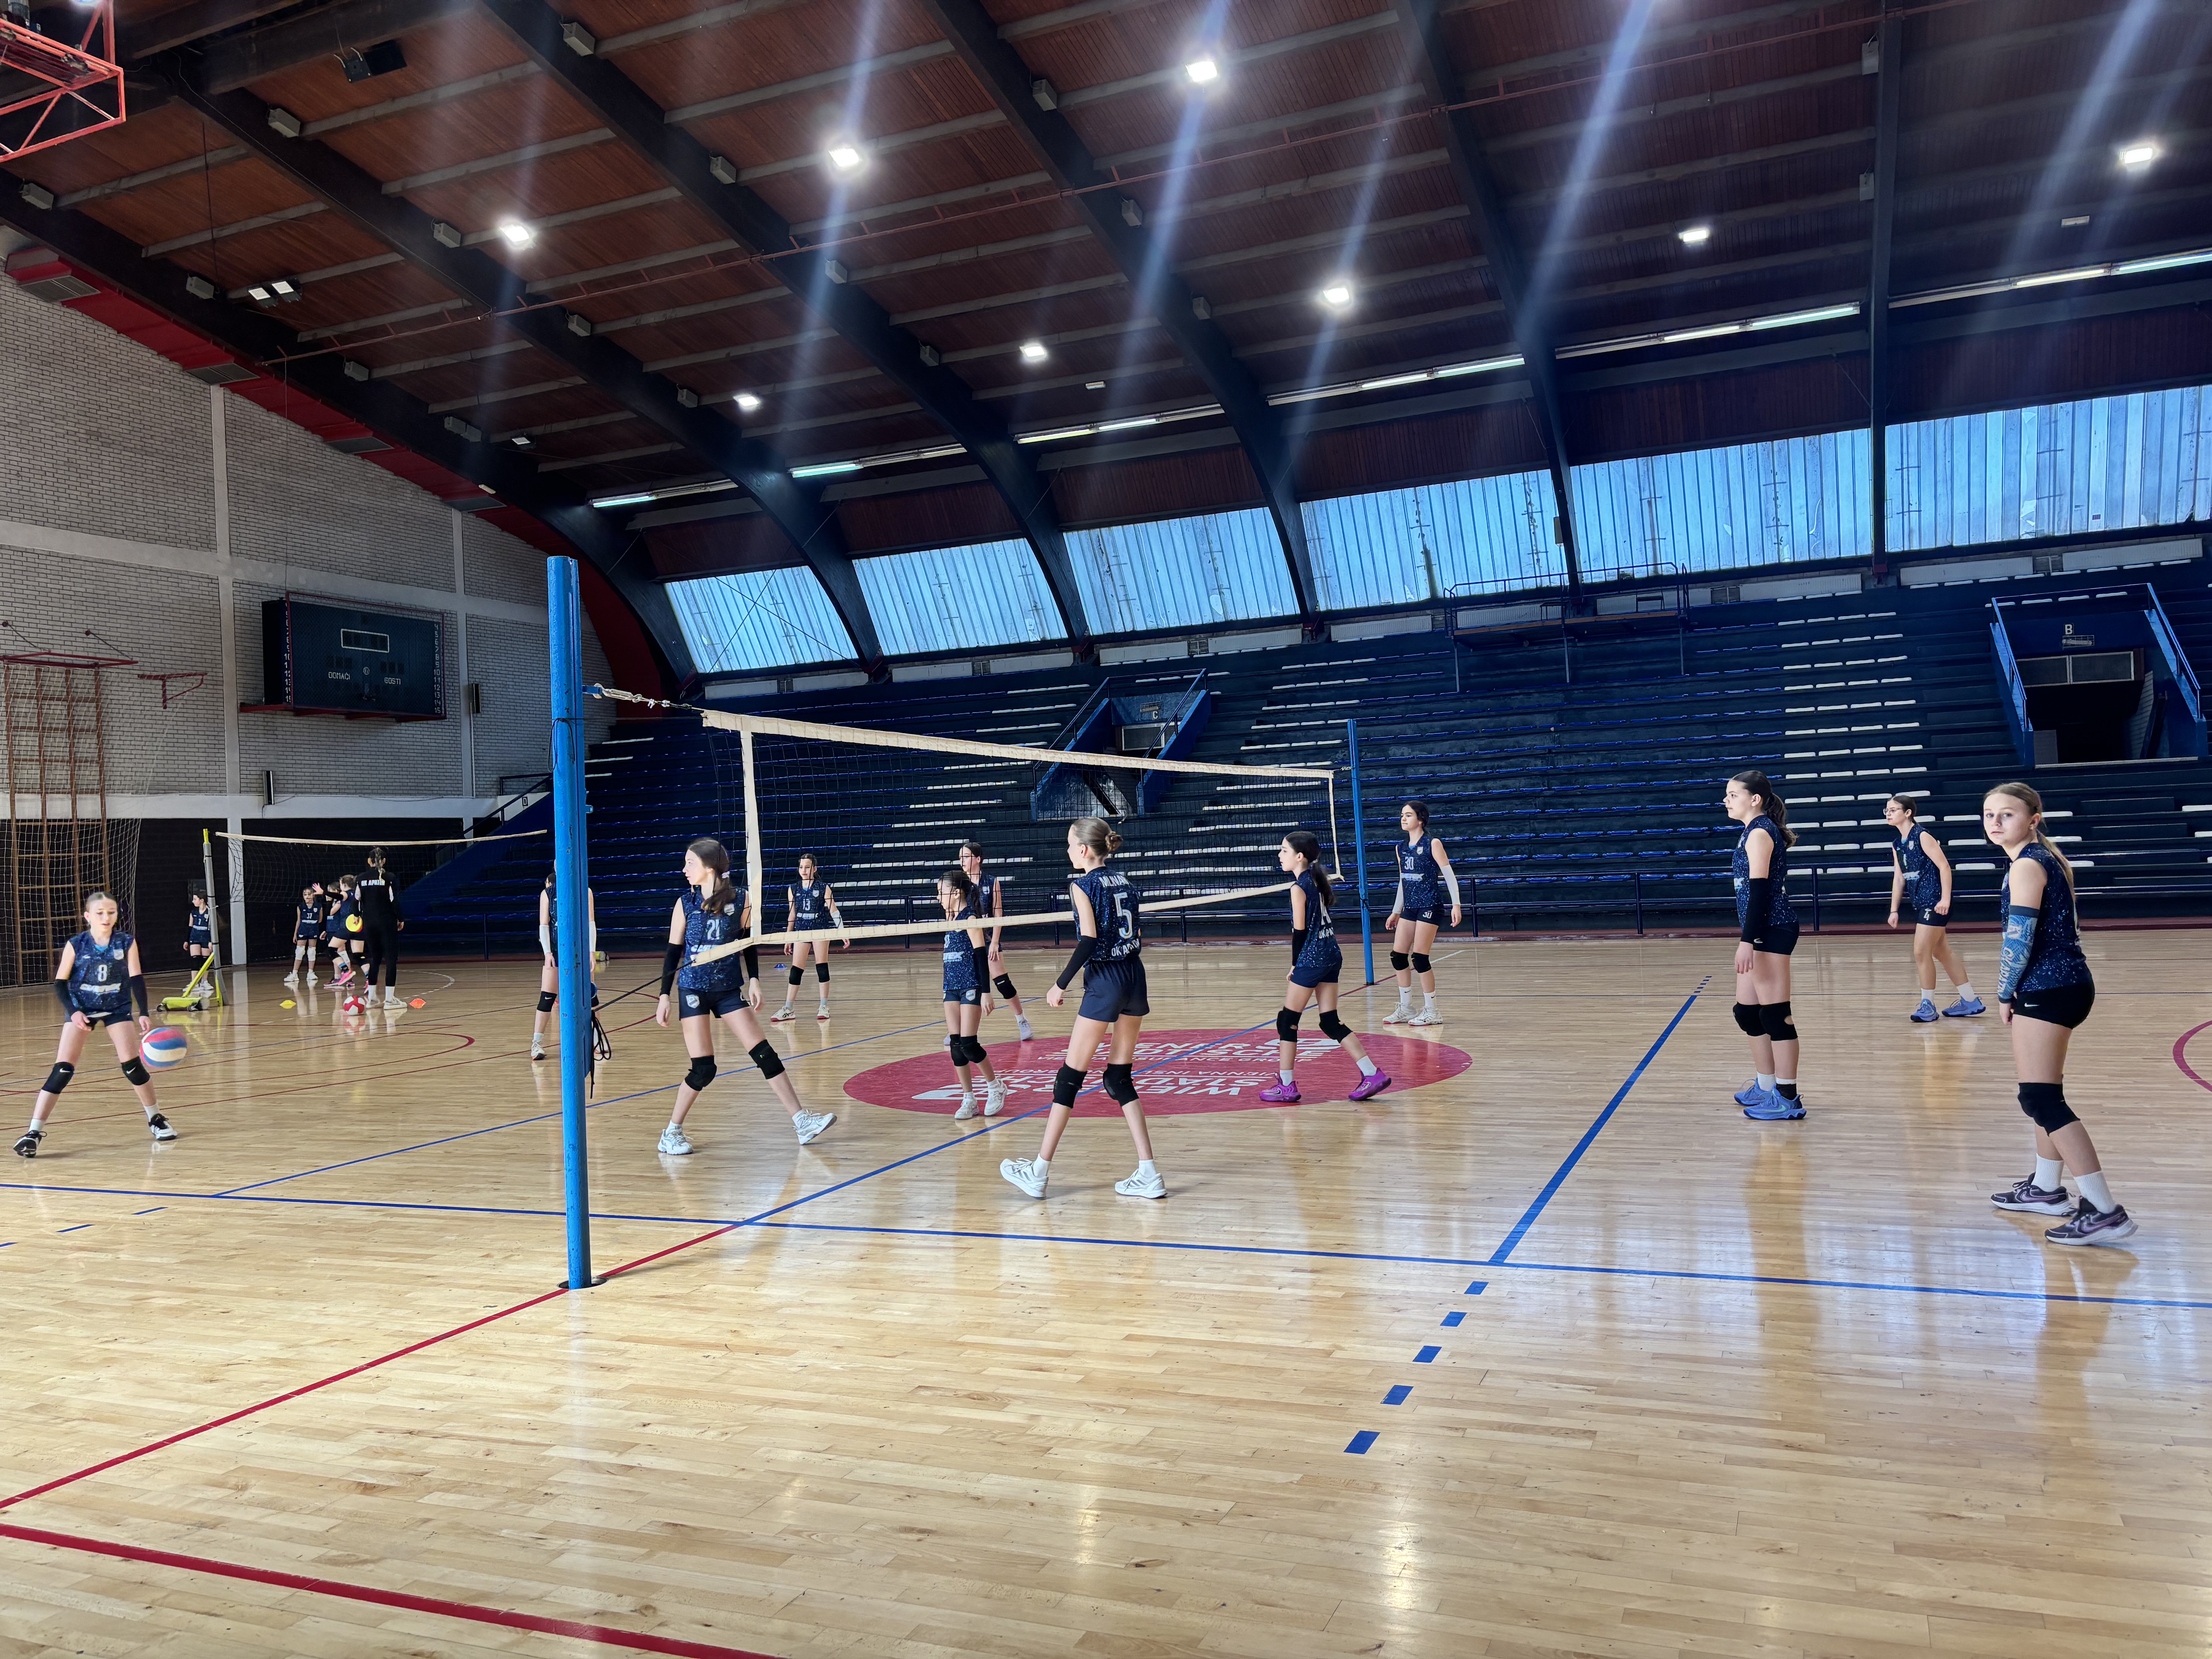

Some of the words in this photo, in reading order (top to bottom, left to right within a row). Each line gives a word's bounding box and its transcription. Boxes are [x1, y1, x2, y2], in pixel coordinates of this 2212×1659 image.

[2065, 624, 2073, 635] B
[1153, 711, 1158, 719] C
[1404, 857, 1414, 870] 30
[803, 899, 811, 911] 13
[1113, 892, 1132, 939] 5
[706, 919, 720, 940] 21
[1111, 946, 1122, 957] OK
[98, 964, 107, 982] 8
